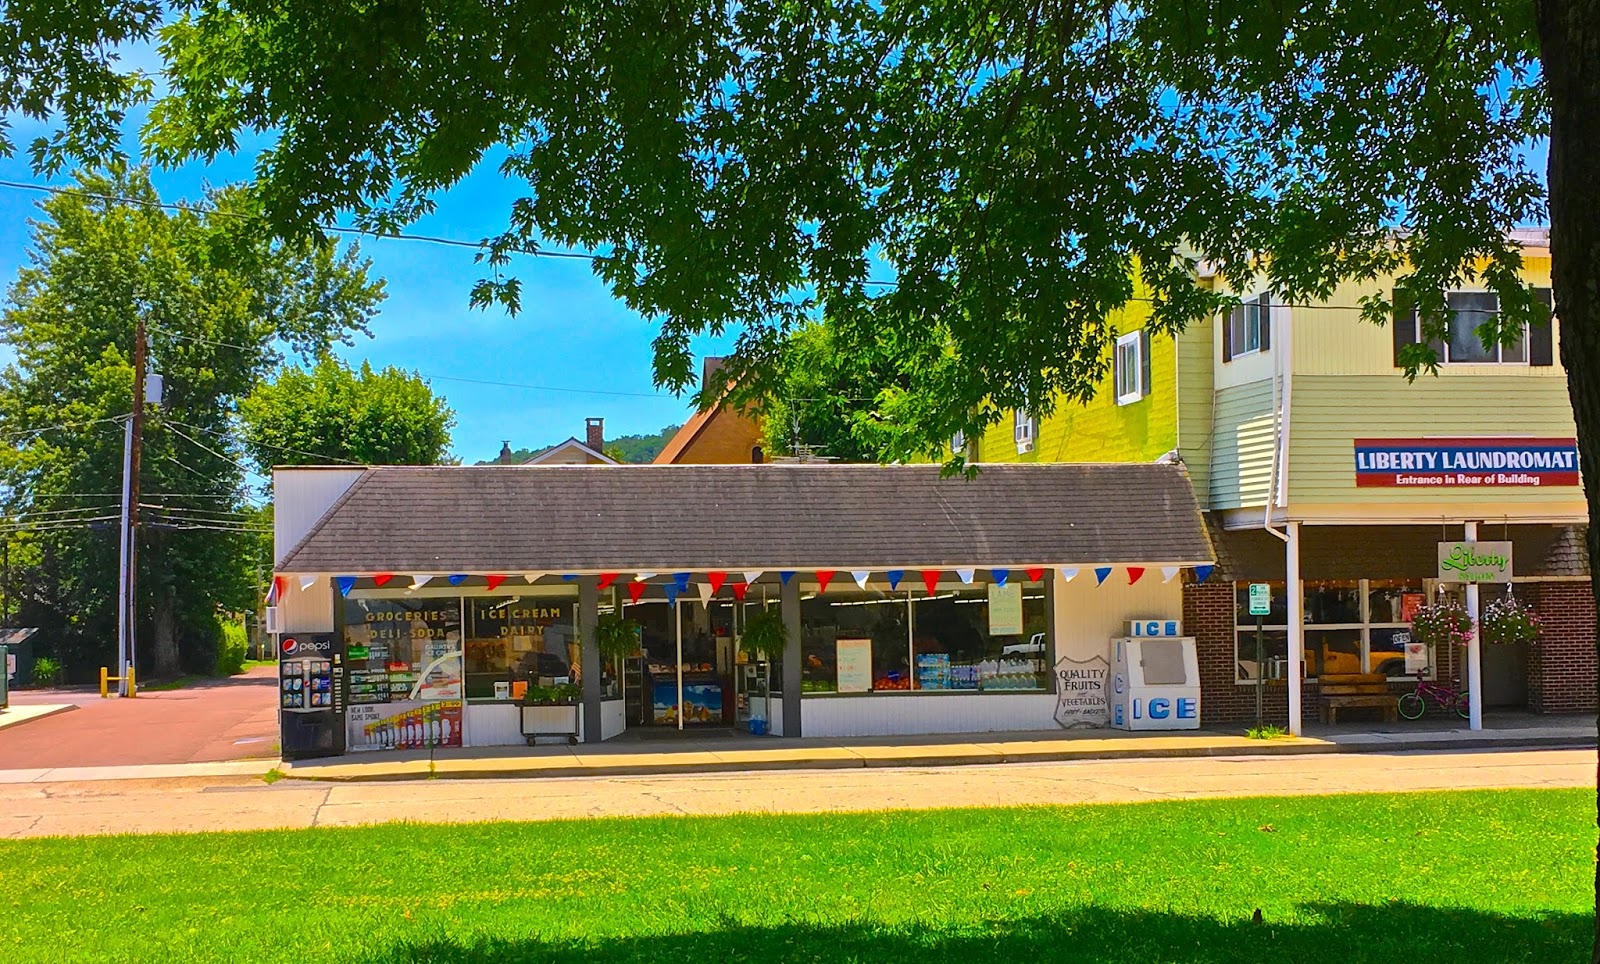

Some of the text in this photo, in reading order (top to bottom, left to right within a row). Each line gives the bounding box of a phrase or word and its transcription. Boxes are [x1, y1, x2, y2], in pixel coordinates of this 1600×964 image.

[1357, 450, 1574, 469] LIBERTY LAUNDROMAT
[1396, 473, 1540, 485] Entrance in Rear of Building
[1441, 543, 1509, 572] Liberty
[365, 610, 447, 622] GROCERIES
[481, 608, 561, 620] ICE CREAM
[370, 628, 445, 639] DELI-SODA
[501, 625, 544, 636] DAIRY
[1135, 621, 1177, 636] ICE
[299, 640, 331, 652] pepsi
[1060, 669, 1105, 681] QUALITY
[1064, 680, 1101, 691] FRUITS
[1114, 641, 1125, 725] ICE
[1061, 697, 1106, 708] VEGETABLES
[1133, 697, 1197, 720] ICE
